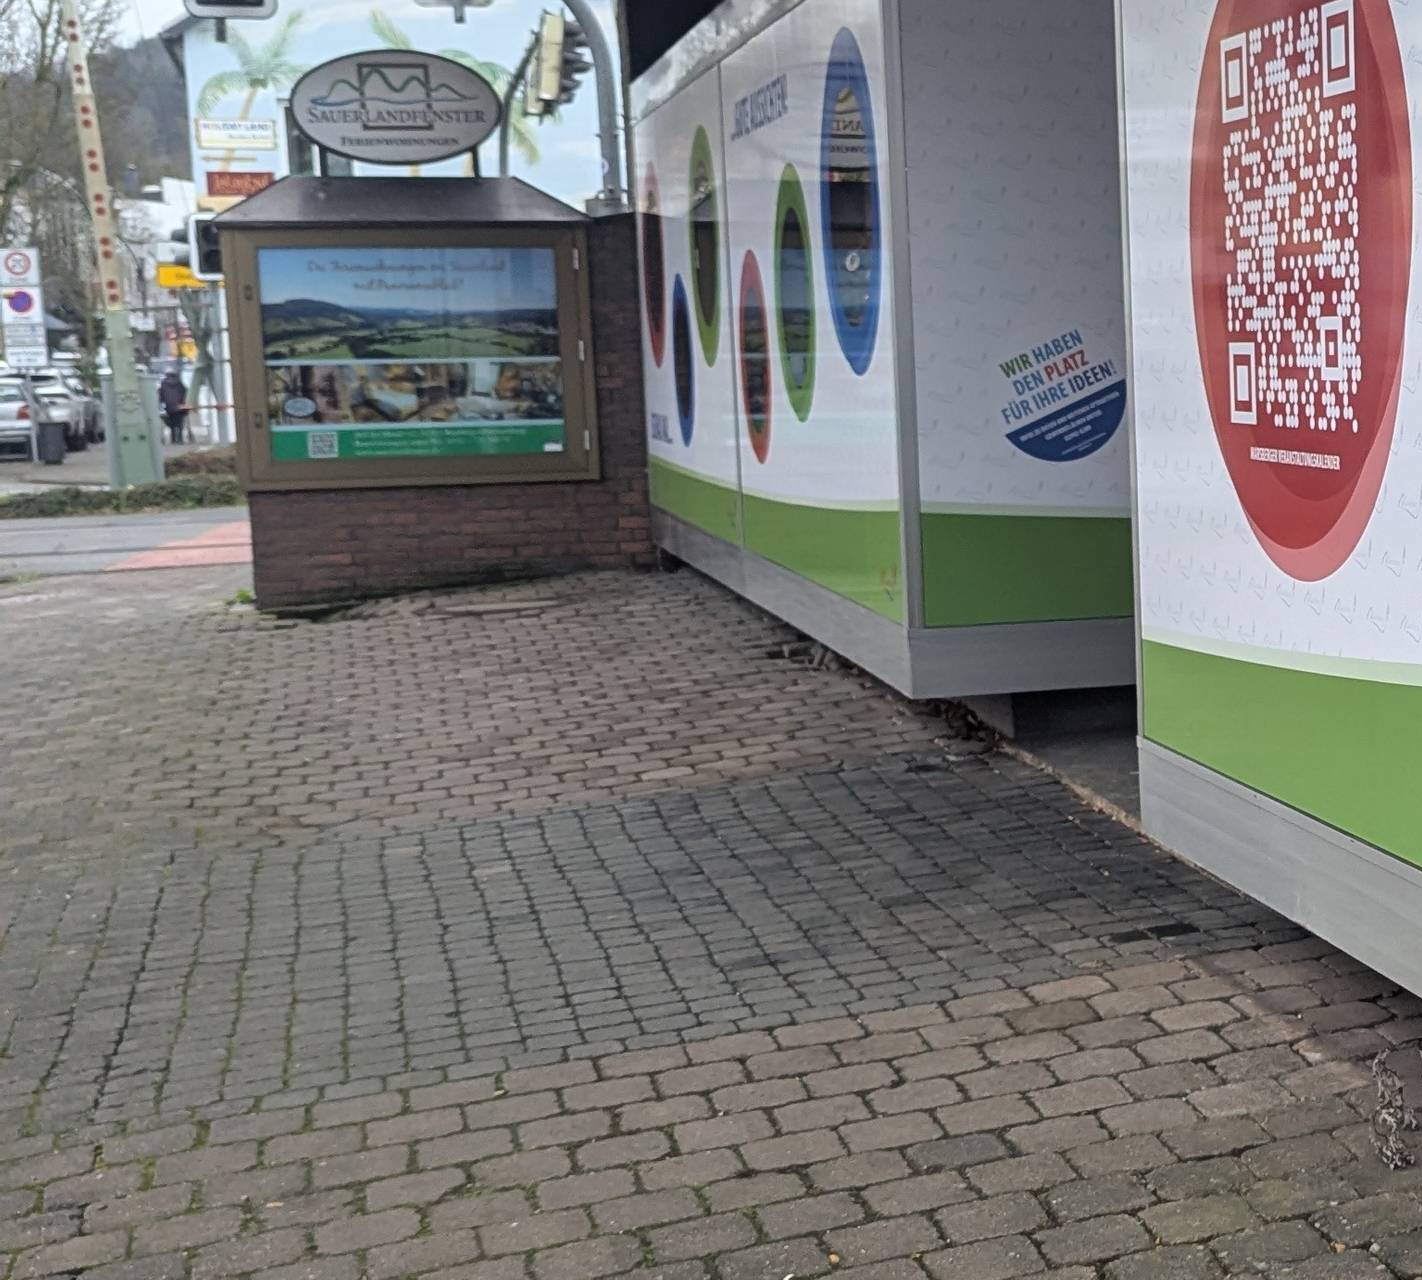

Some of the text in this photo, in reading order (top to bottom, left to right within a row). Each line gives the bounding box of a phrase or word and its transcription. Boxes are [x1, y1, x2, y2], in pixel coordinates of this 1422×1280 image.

[308, 107, 487, 123] SAUERLANDFENSTER
[998, 328, 1084, 379] WIR HABEN
[1012, 348, 1090, 397] DEN PLATZ
[1000, 398, 1034, 425] FÜR
[1032, 381, 1070, 411] IHRE
[1067, 359, 1118, 394] IDEEN!
